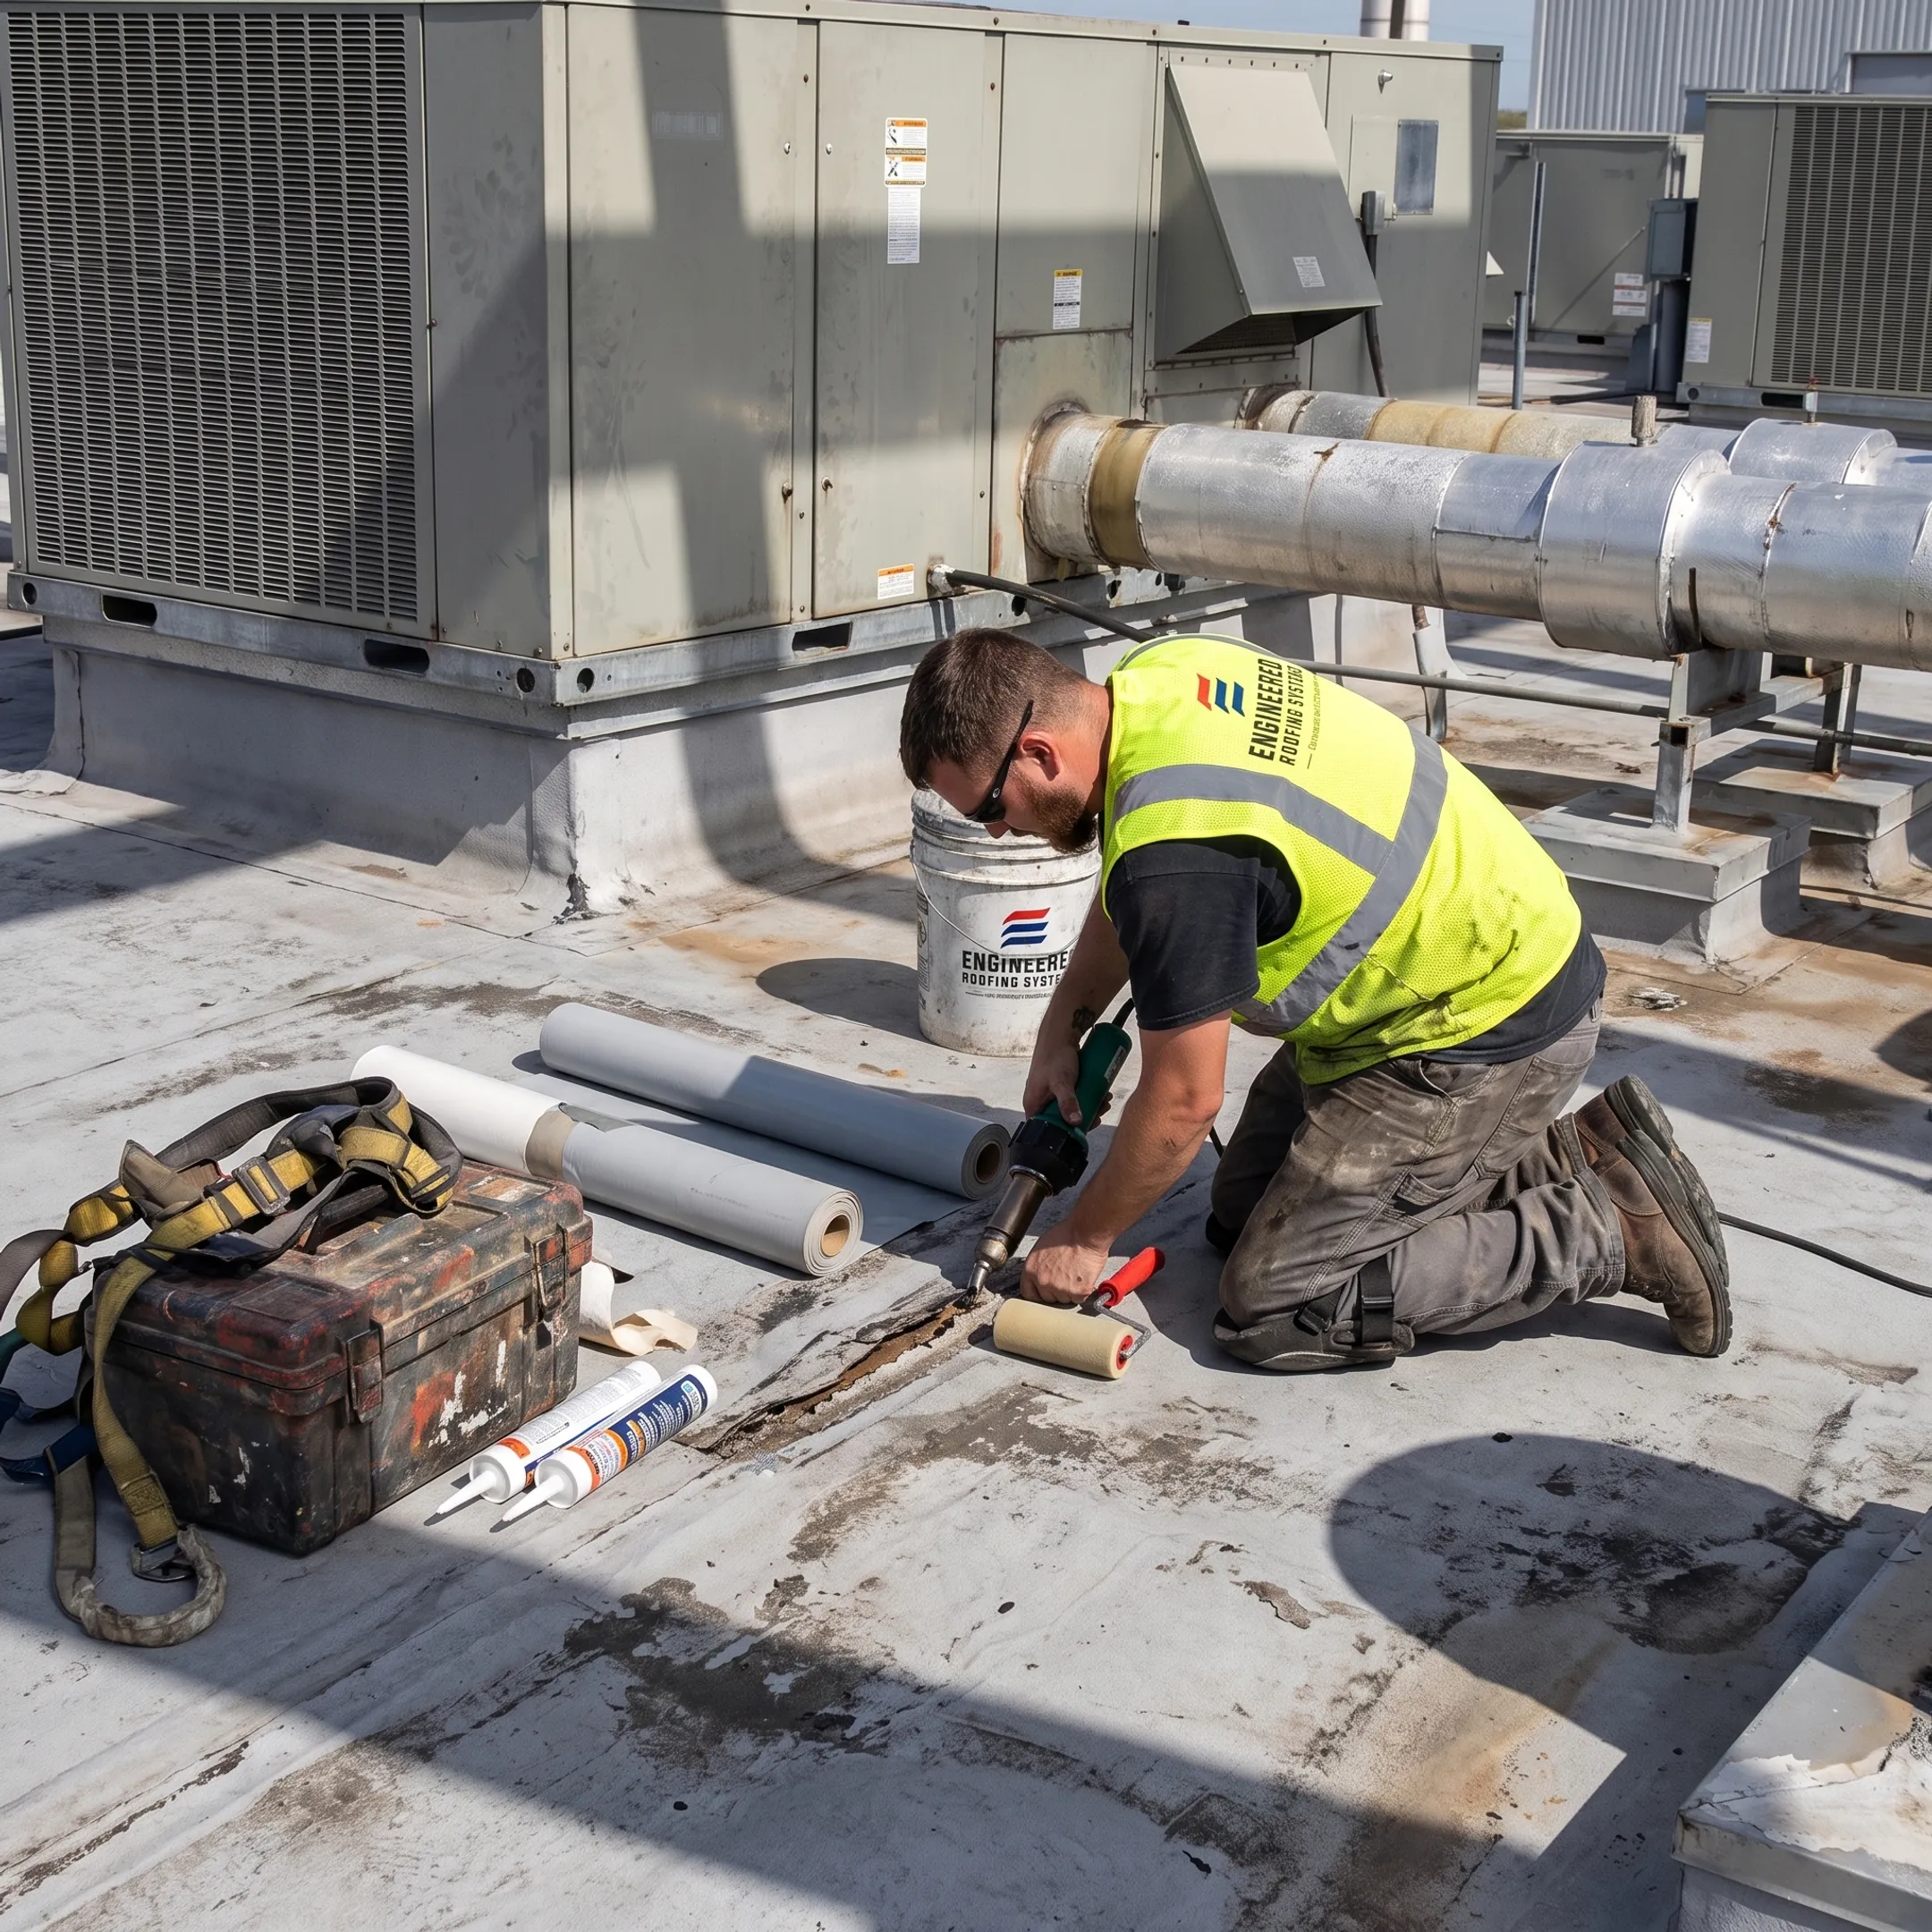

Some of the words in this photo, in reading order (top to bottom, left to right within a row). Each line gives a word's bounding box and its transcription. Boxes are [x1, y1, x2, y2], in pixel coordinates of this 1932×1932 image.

[1249, 658, 1284, 761] ENGINEERED
[1279, 708, 1303, 767] ROOFING
[962, 950, 1072, 974] ENGINEERE
[962, 971, 1019, 988] ROOFING
[1023, 973, 1062, 988] SYSTE
